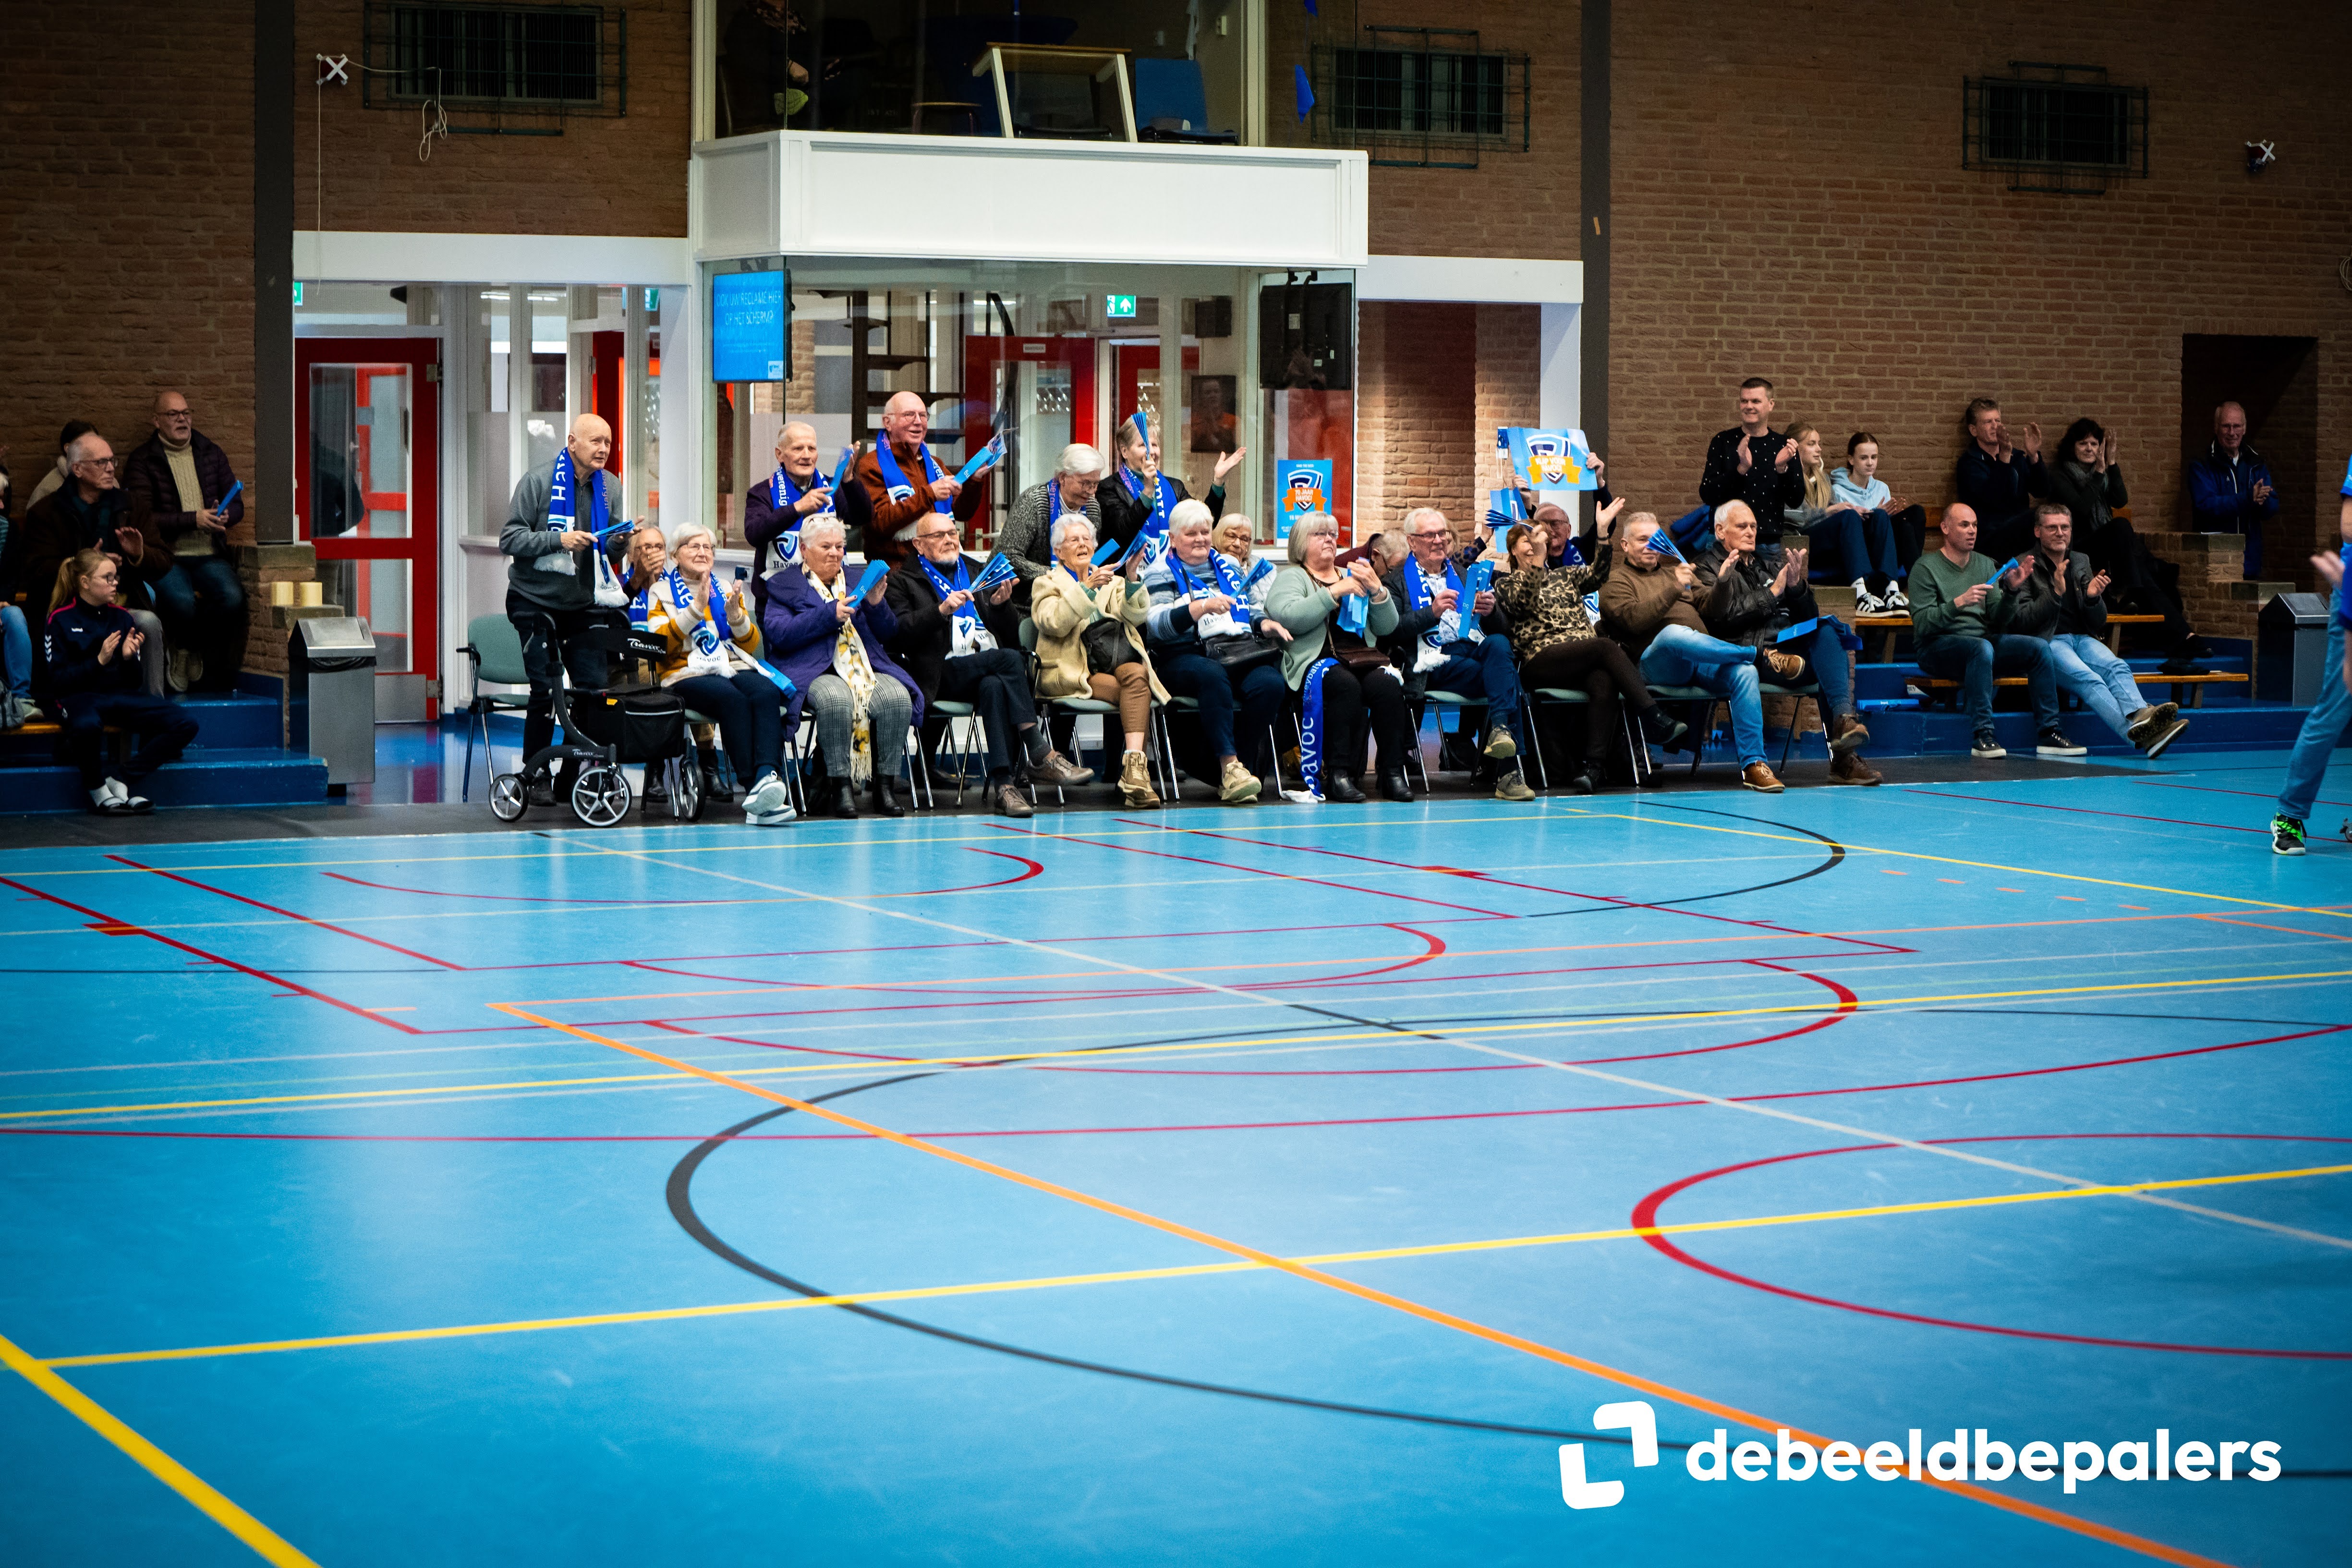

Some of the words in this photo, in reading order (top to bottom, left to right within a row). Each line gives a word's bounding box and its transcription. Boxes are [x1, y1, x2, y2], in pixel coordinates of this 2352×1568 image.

[716, 293, 729, 307] OOK
[729, 292, 740, 306] UW
[740, 291, 768, 306] RECLAME
[768, 290, 782, 304] HIER
[725, 313, 733, 325] OP
[734, 312, 745, 326] HET
[746, 310, 774, 325] SCHERM?
[1535, 458, 1549, 466] KLAP
[1550, 458, 1566, 466] VOOR
[1301, 717, 1318, 789] avoc
